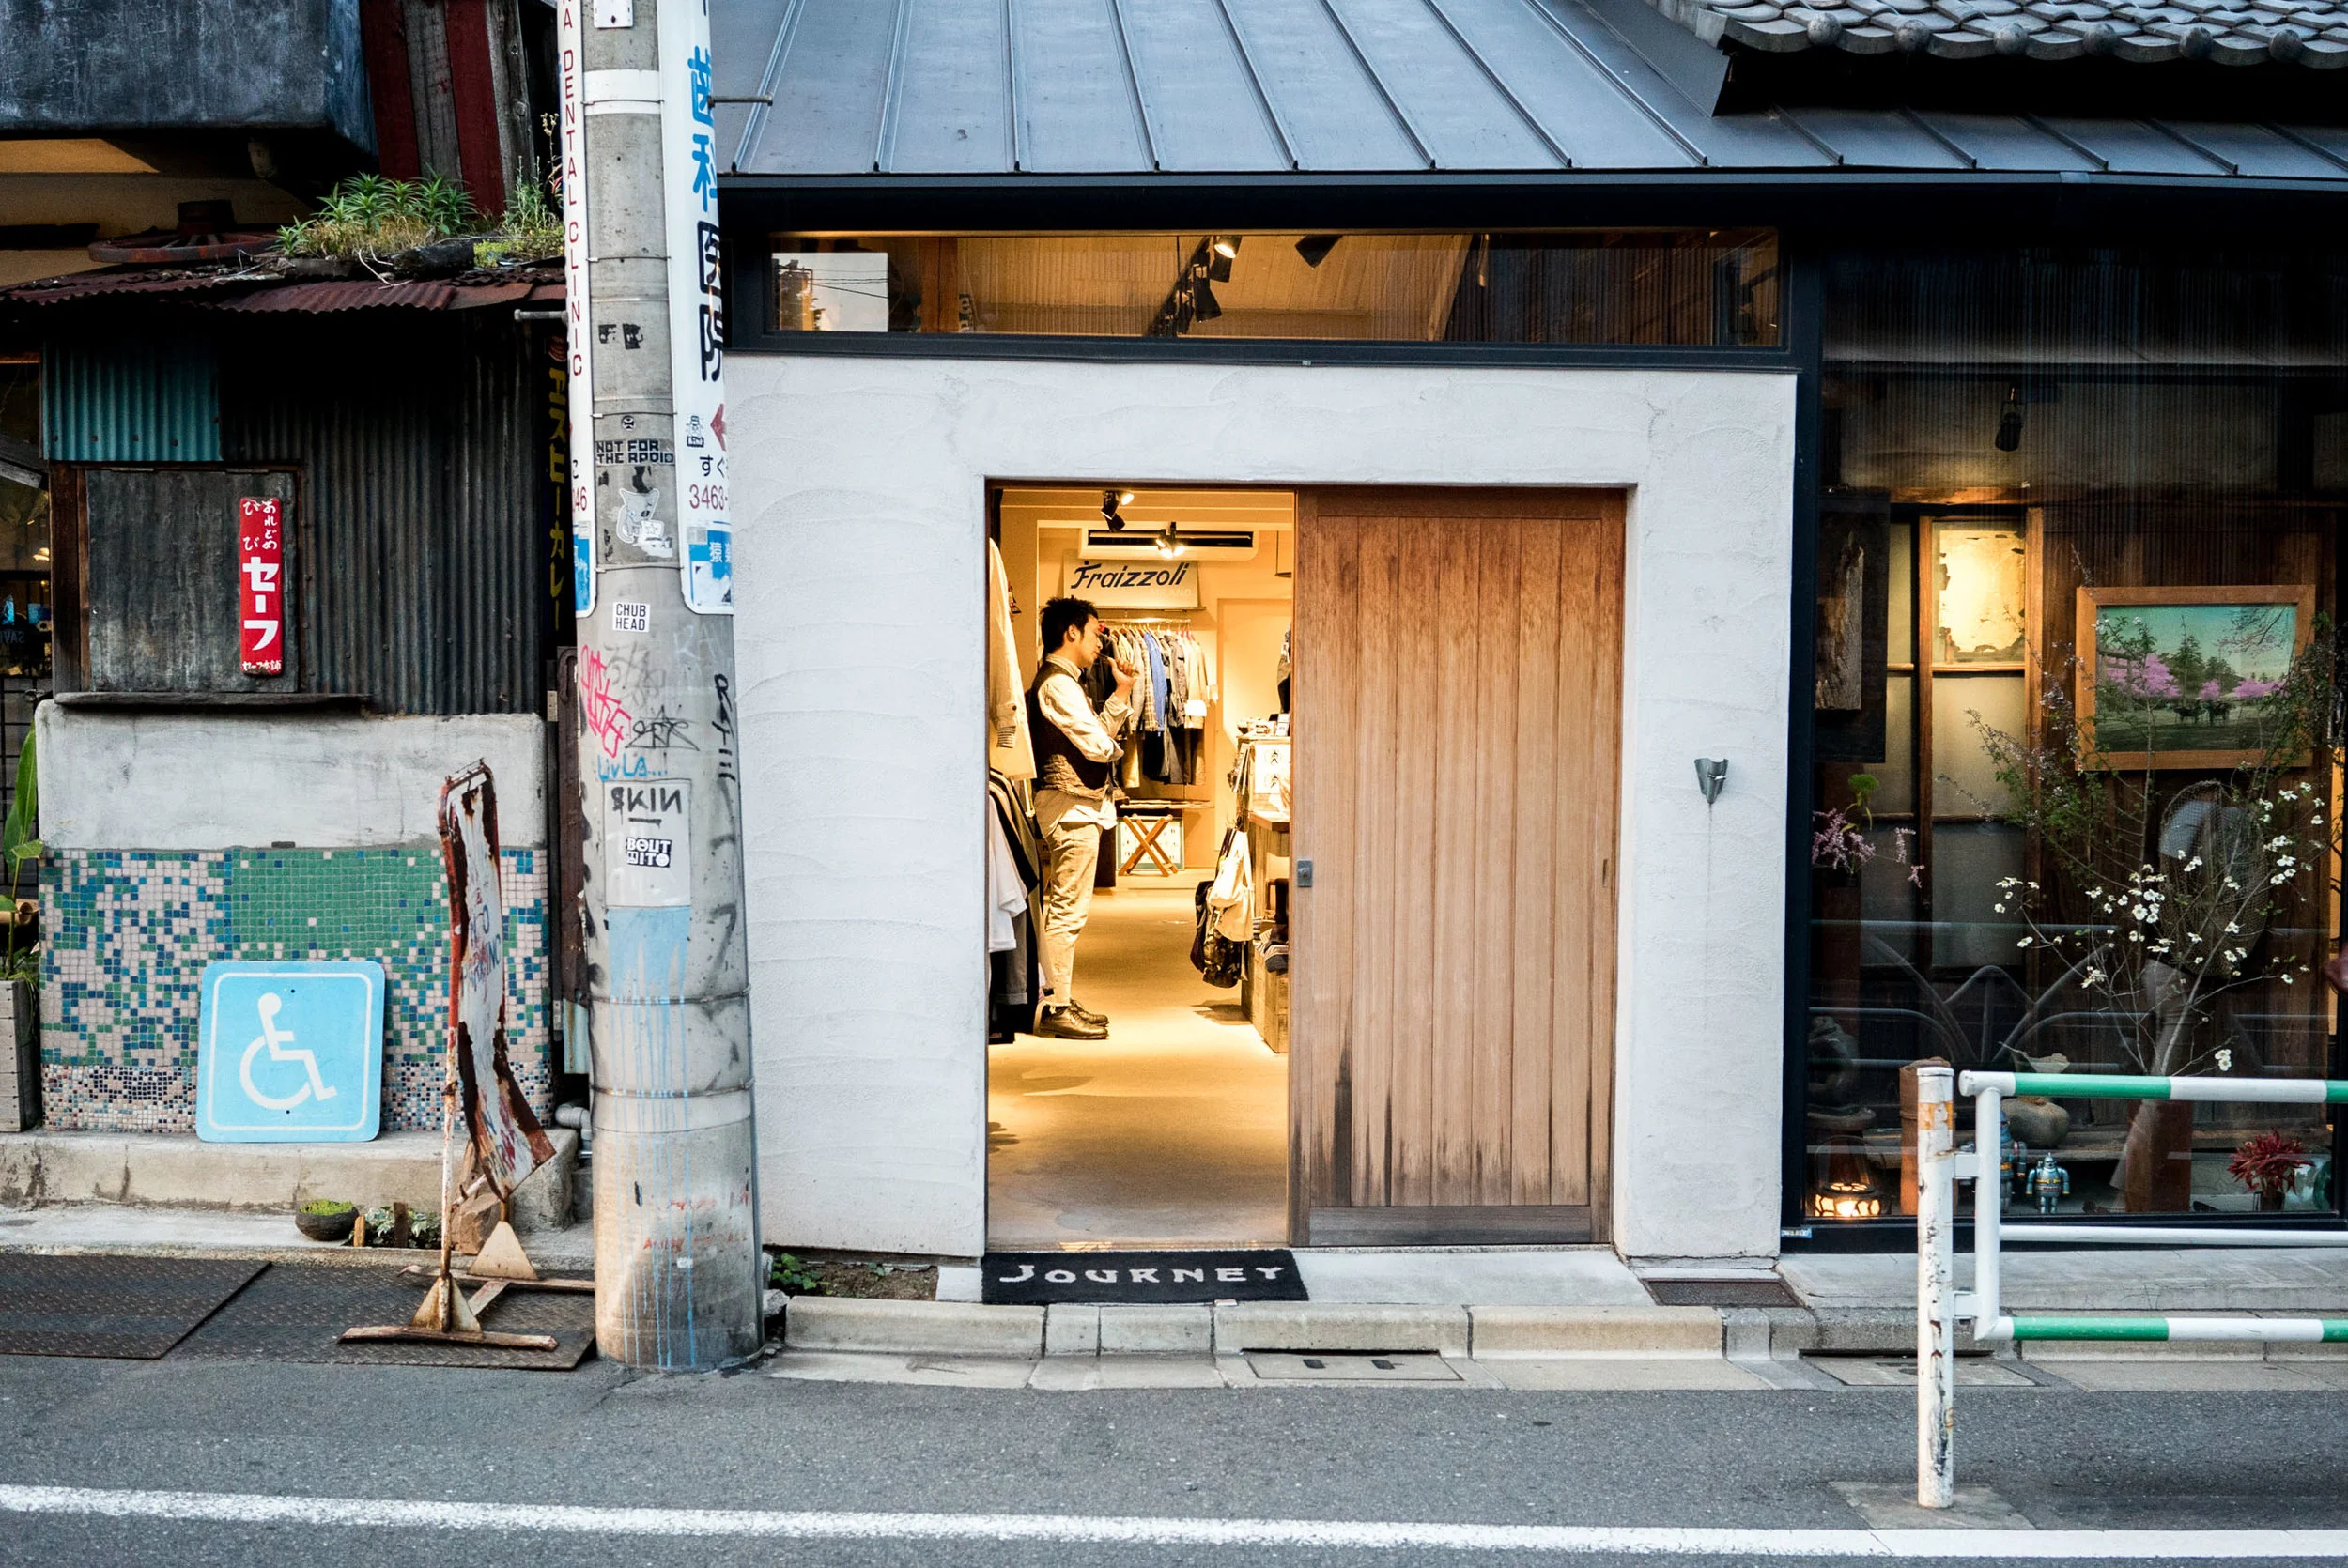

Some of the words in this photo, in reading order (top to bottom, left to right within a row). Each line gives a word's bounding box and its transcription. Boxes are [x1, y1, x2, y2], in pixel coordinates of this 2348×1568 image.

[564, 49, 578, 206] DENTAL
[568, 221, 583, 376] CLINIC
[627, 440, 659, 452] FOR
[596, 453, 625, 464] THE
[1071, 560, 1190, 589] Fraizzoli
[242, 556, 280, 652] セーフ
[616, 604, 646, 617] CHUB
[616, 618, 646, 631] HEAD
